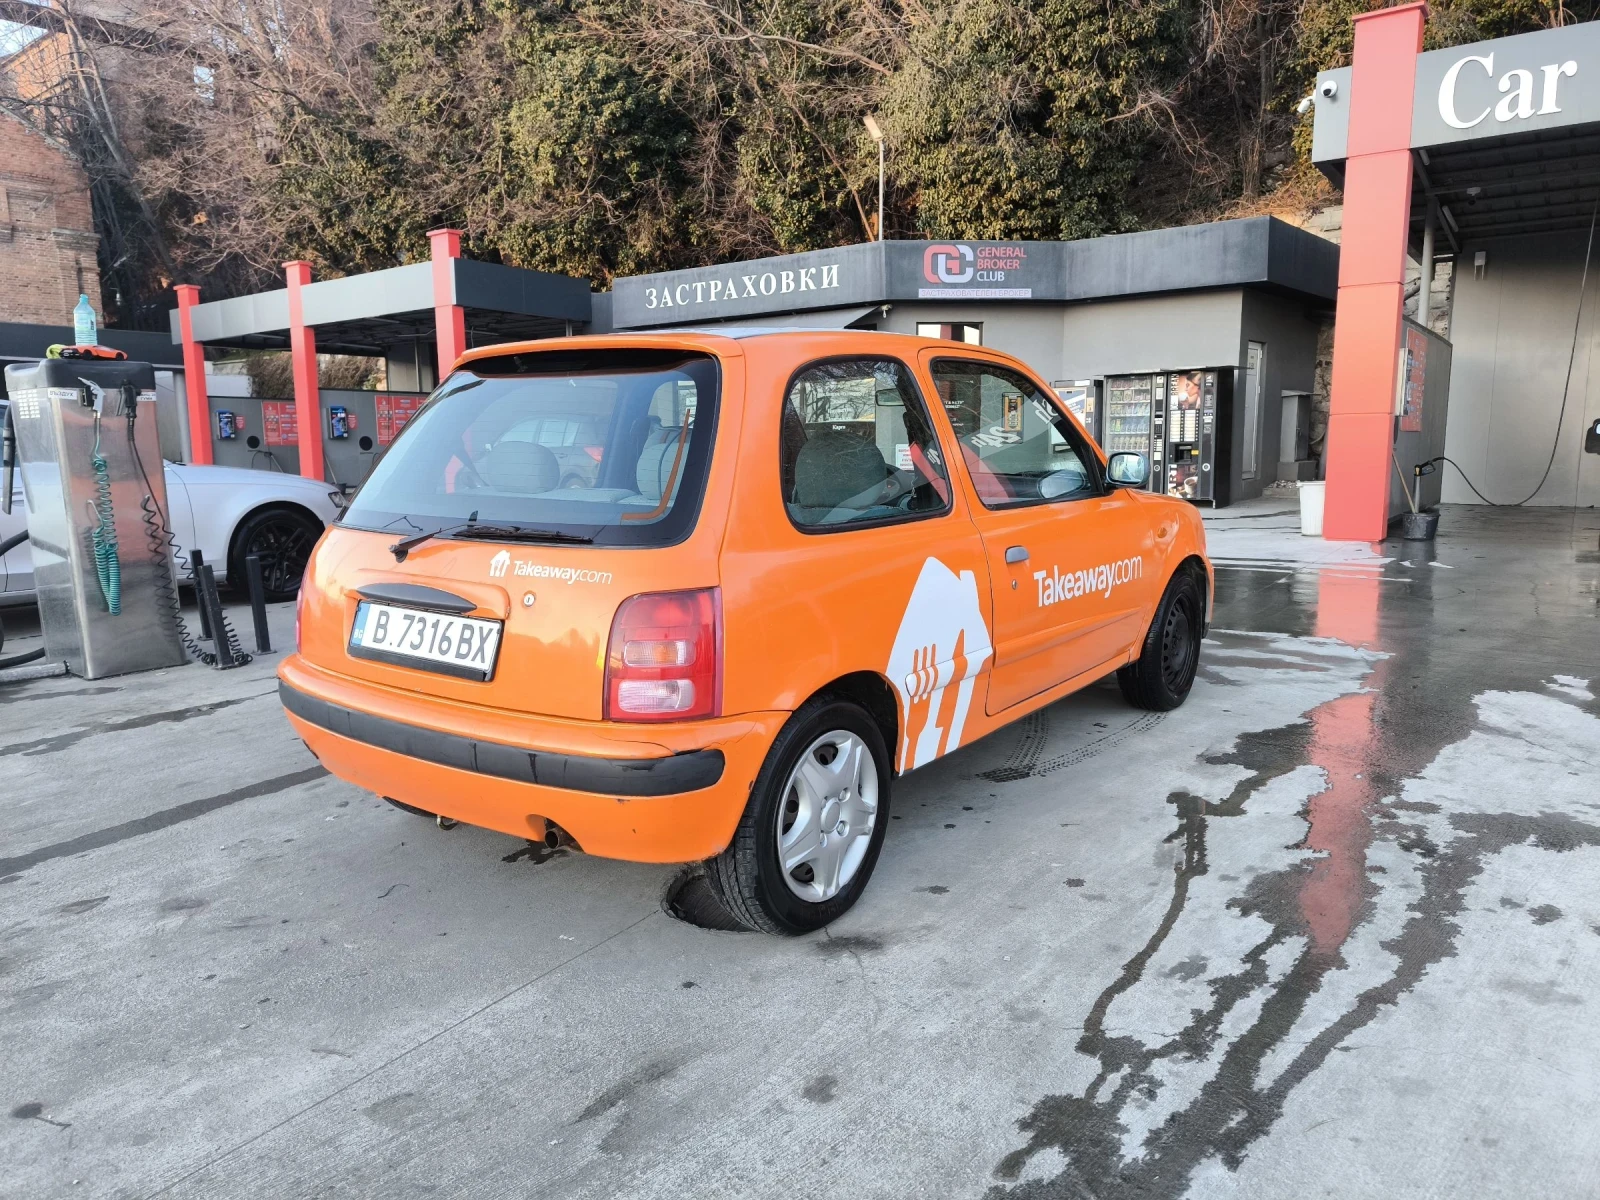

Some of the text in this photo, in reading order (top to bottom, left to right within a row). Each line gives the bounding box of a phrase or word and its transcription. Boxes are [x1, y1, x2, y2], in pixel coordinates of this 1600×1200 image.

[1438, 52, 1577, 129] Car
[977, 247, 1027, 258] GENERAL
[977, 259, 1020, 269] BROKER
[976, 271, 1005, 281] CLUB
[645, 264, 840, 309] ЗАСТРАХОВКИ
[513, 560, 613, 585] Takeaway.com
[1033, 555, 1142, 607] Takeaway.com
[353, 628, 364, 639] BG
